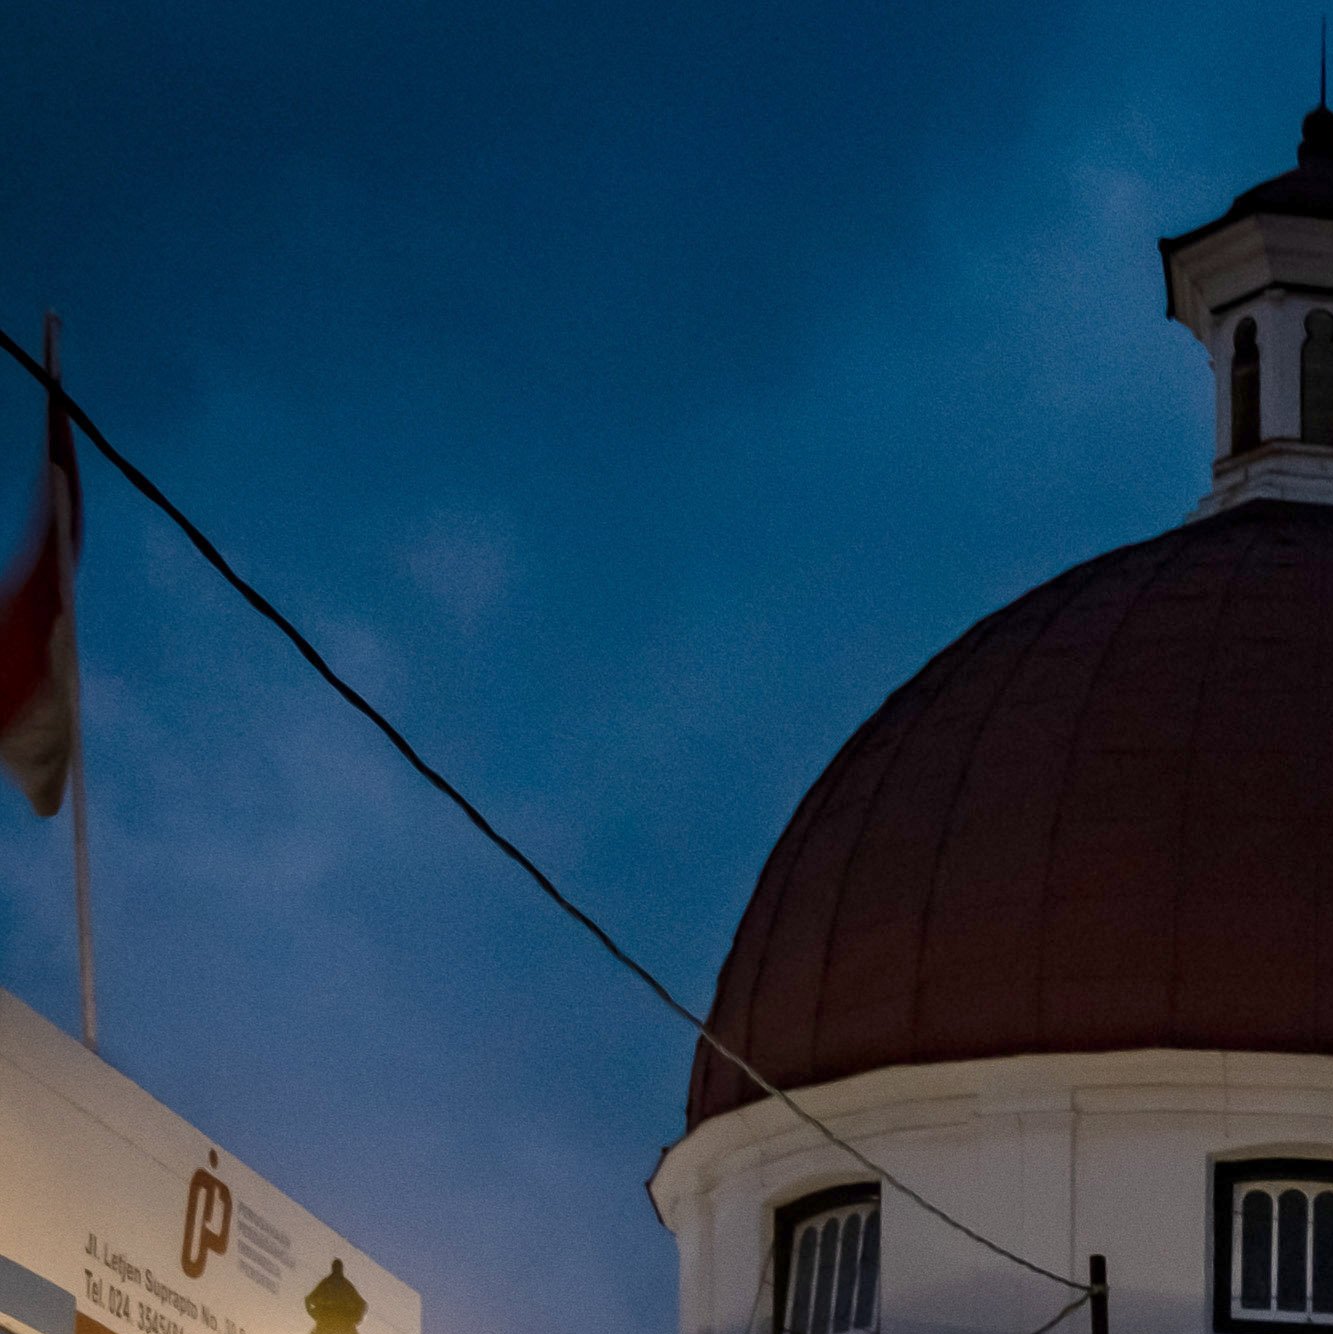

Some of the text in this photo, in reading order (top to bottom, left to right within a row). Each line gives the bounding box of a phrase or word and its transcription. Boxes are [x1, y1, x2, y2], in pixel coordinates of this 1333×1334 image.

[85, 1233, 100, 1259] Jl.
[104, 1243, 141, 1284] Letjen
[145, 1269, 198, 1320] Suprapto
[85, 1268, 105, 1308] Tel.
